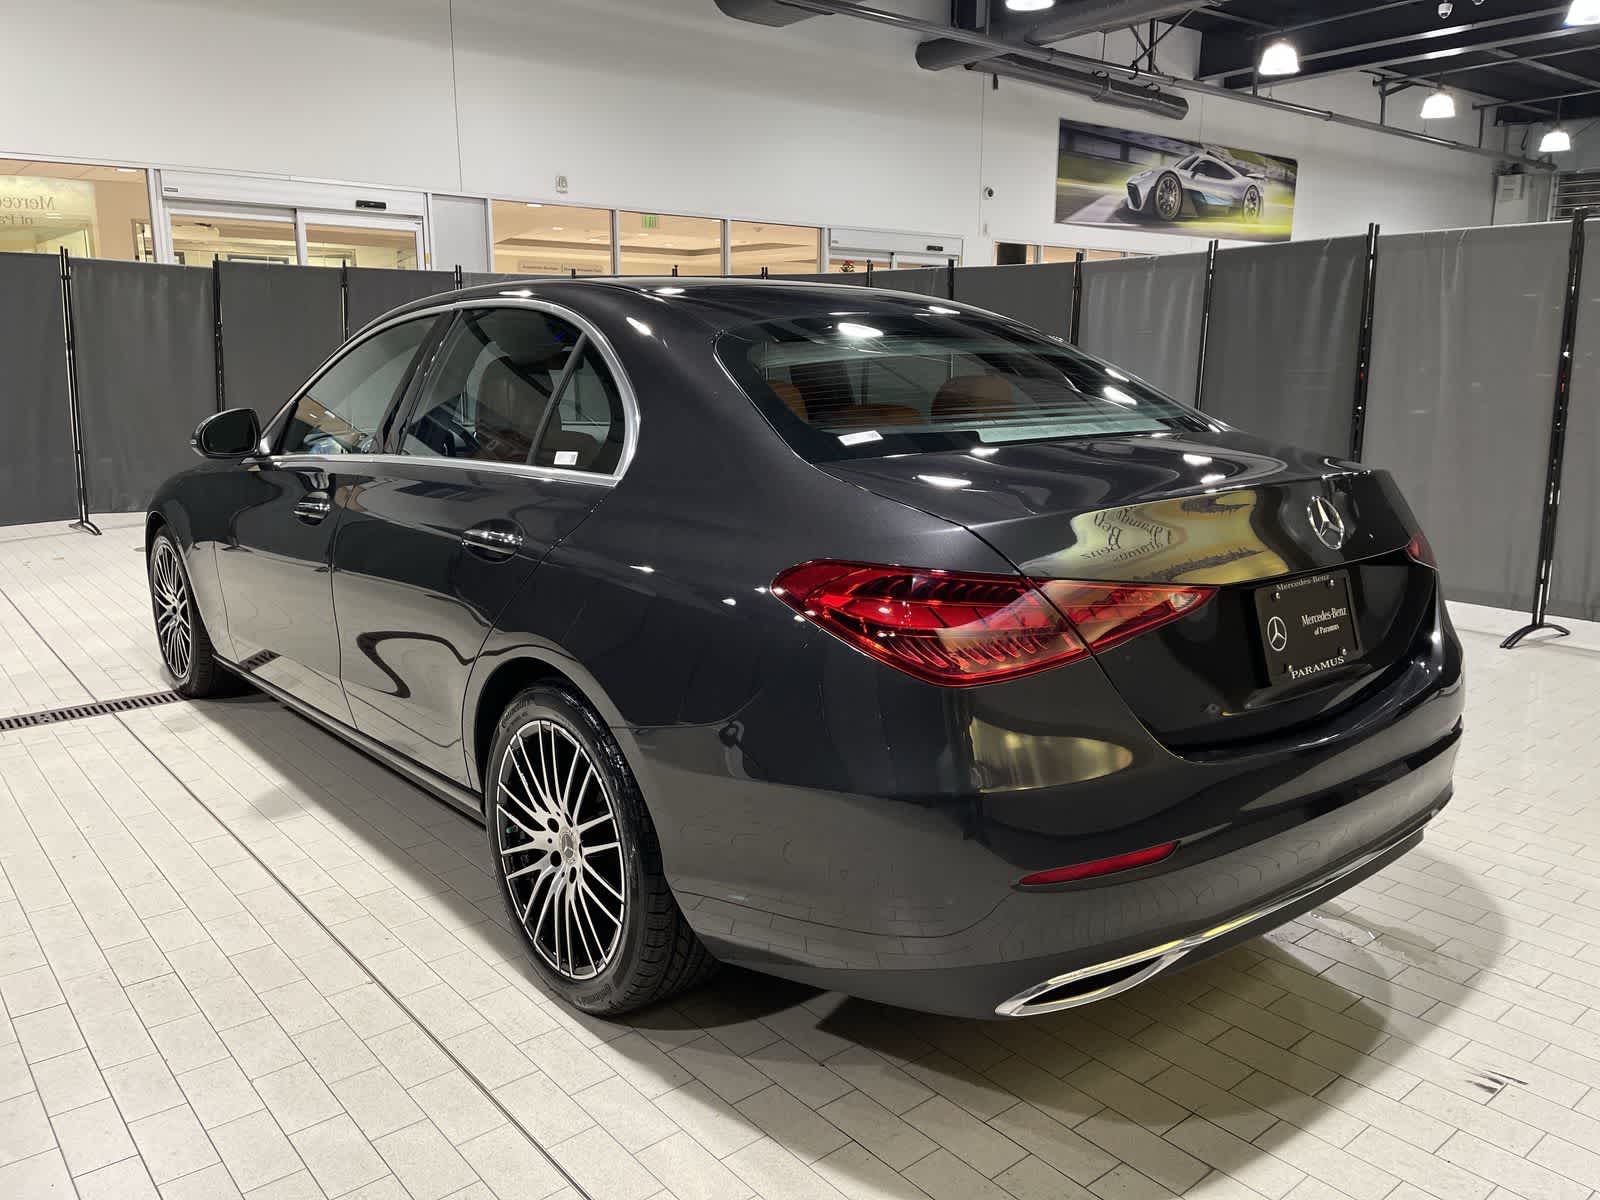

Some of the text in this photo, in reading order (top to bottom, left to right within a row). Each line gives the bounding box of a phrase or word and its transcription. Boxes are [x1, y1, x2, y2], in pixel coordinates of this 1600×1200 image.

[1276, 575, 1330, 592] Mercedes-Benz
[1301, 607, 1347, 626] Mercedes-Benz
[1320, 624, 1340, 634] Paramus
[1291, 656, 1345, 680] PARAMUS
